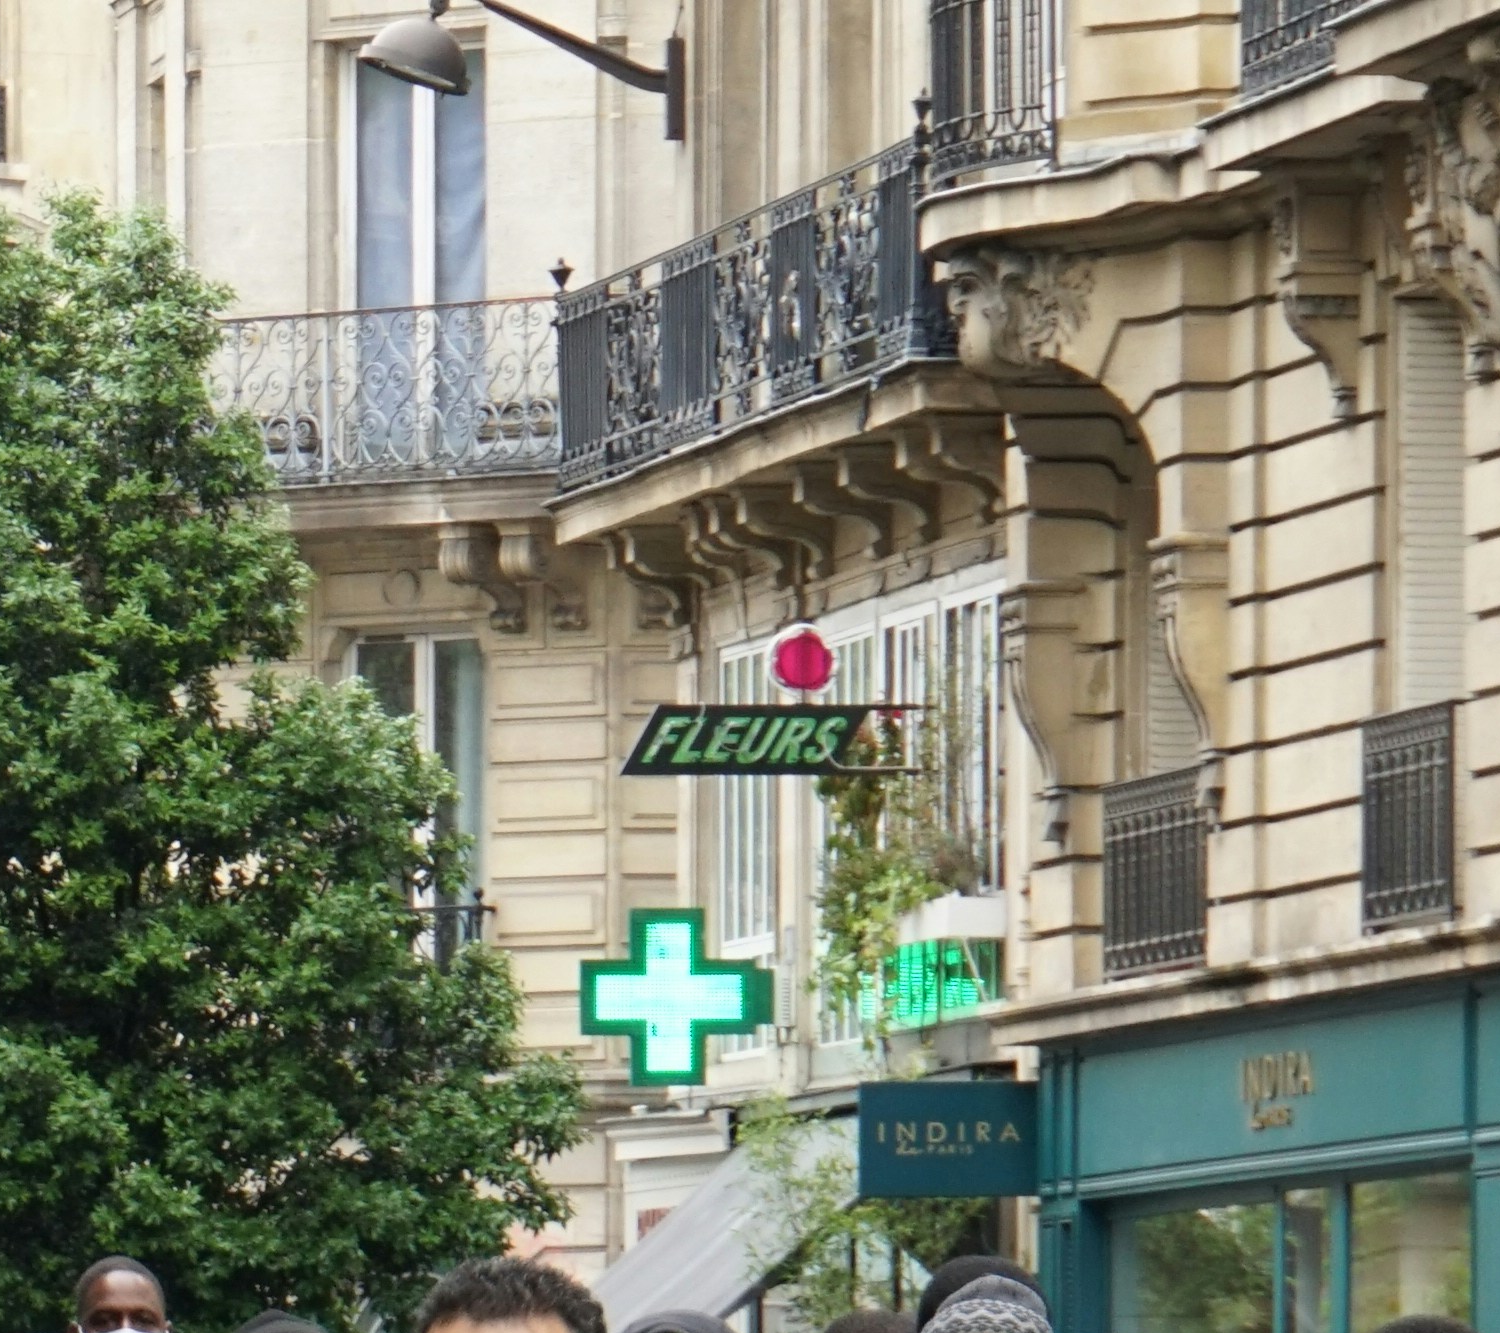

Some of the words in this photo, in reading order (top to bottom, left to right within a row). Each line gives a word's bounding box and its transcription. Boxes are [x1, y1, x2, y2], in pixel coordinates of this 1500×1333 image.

[641, 716, 848, 764] FLEURS
[1242, 1051, 1313, 1102] INDIRA
[876, 1120, 1021, 1144] INDIRA
